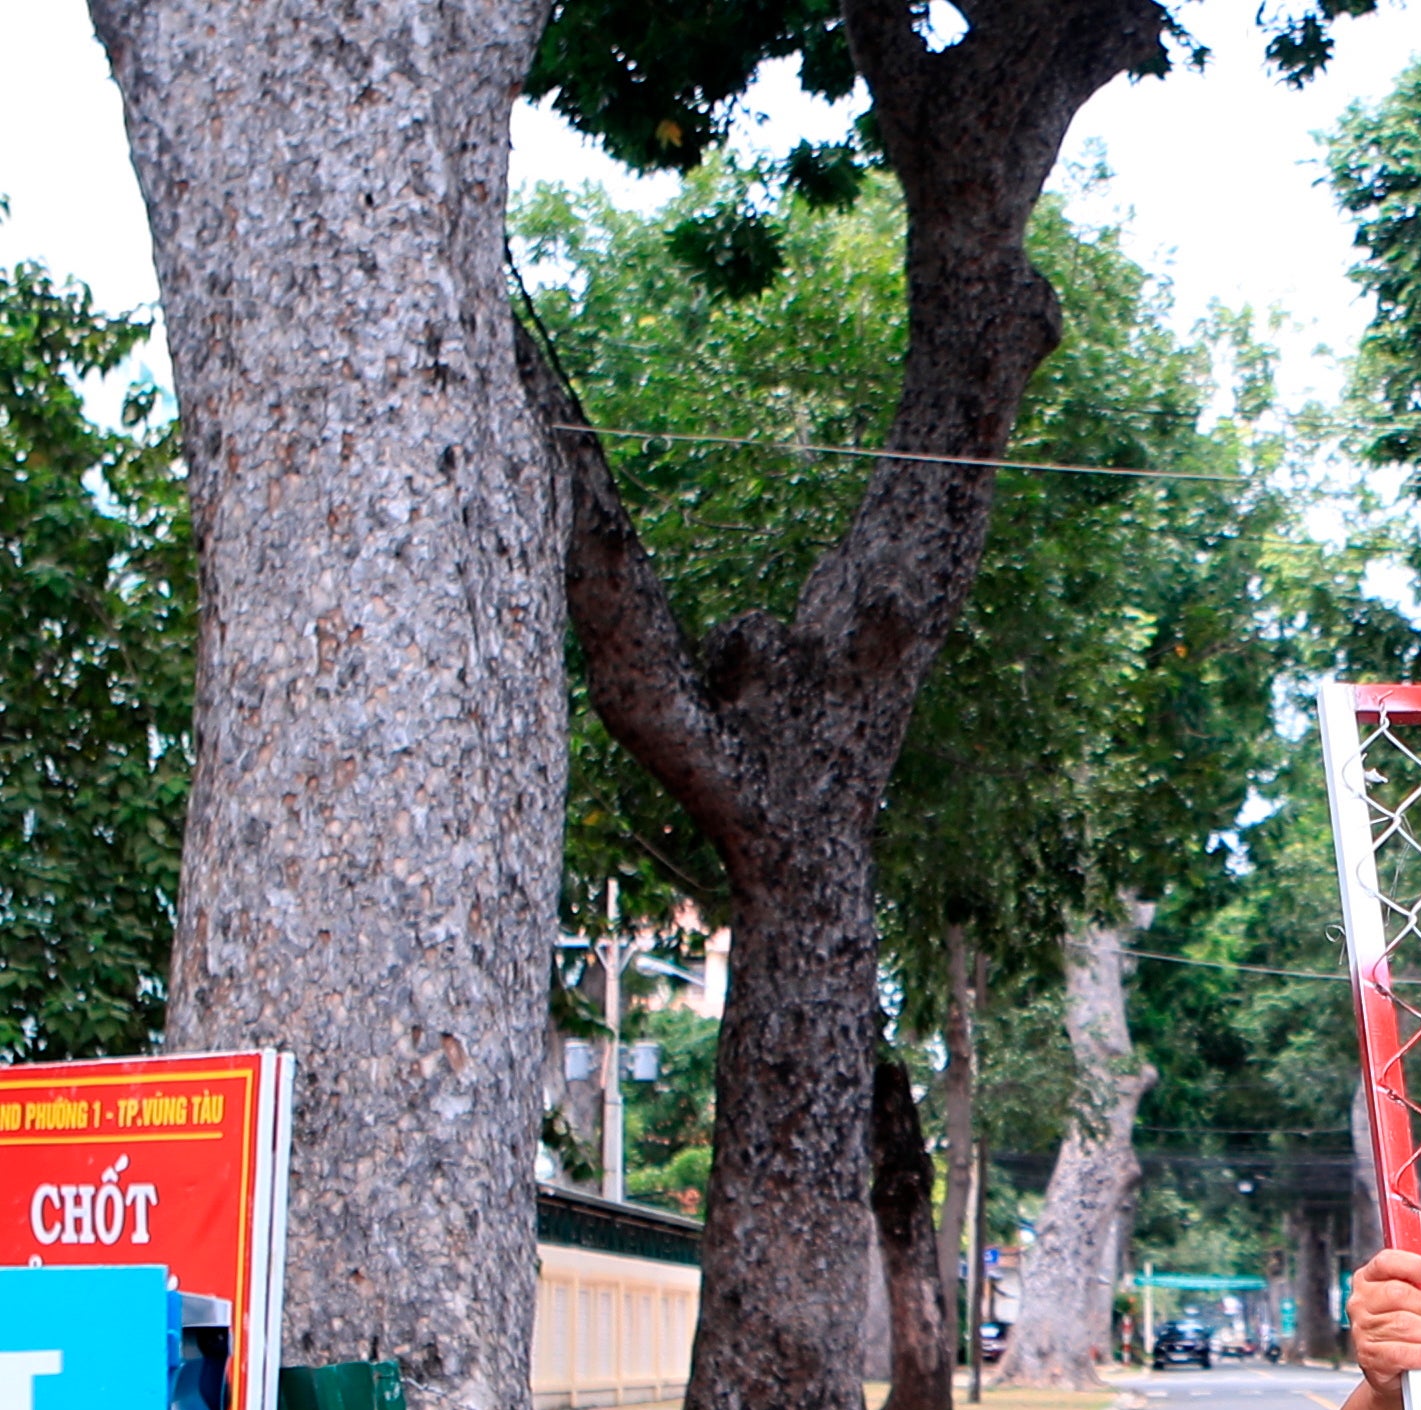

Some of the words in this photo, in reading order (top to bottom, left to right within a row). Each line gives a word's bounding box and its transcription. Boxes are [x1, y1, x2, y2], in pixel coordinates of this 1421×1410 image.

[25, 1095, 88, 1131] PHƯỜNG
[92, 1100, 102, 1129] 1
[117, 1091, 187, 1128] TP.VŨNG
[191, 1089, 224, 1126] TÀU
[30, 1153, 159, 1246] CHỐT
